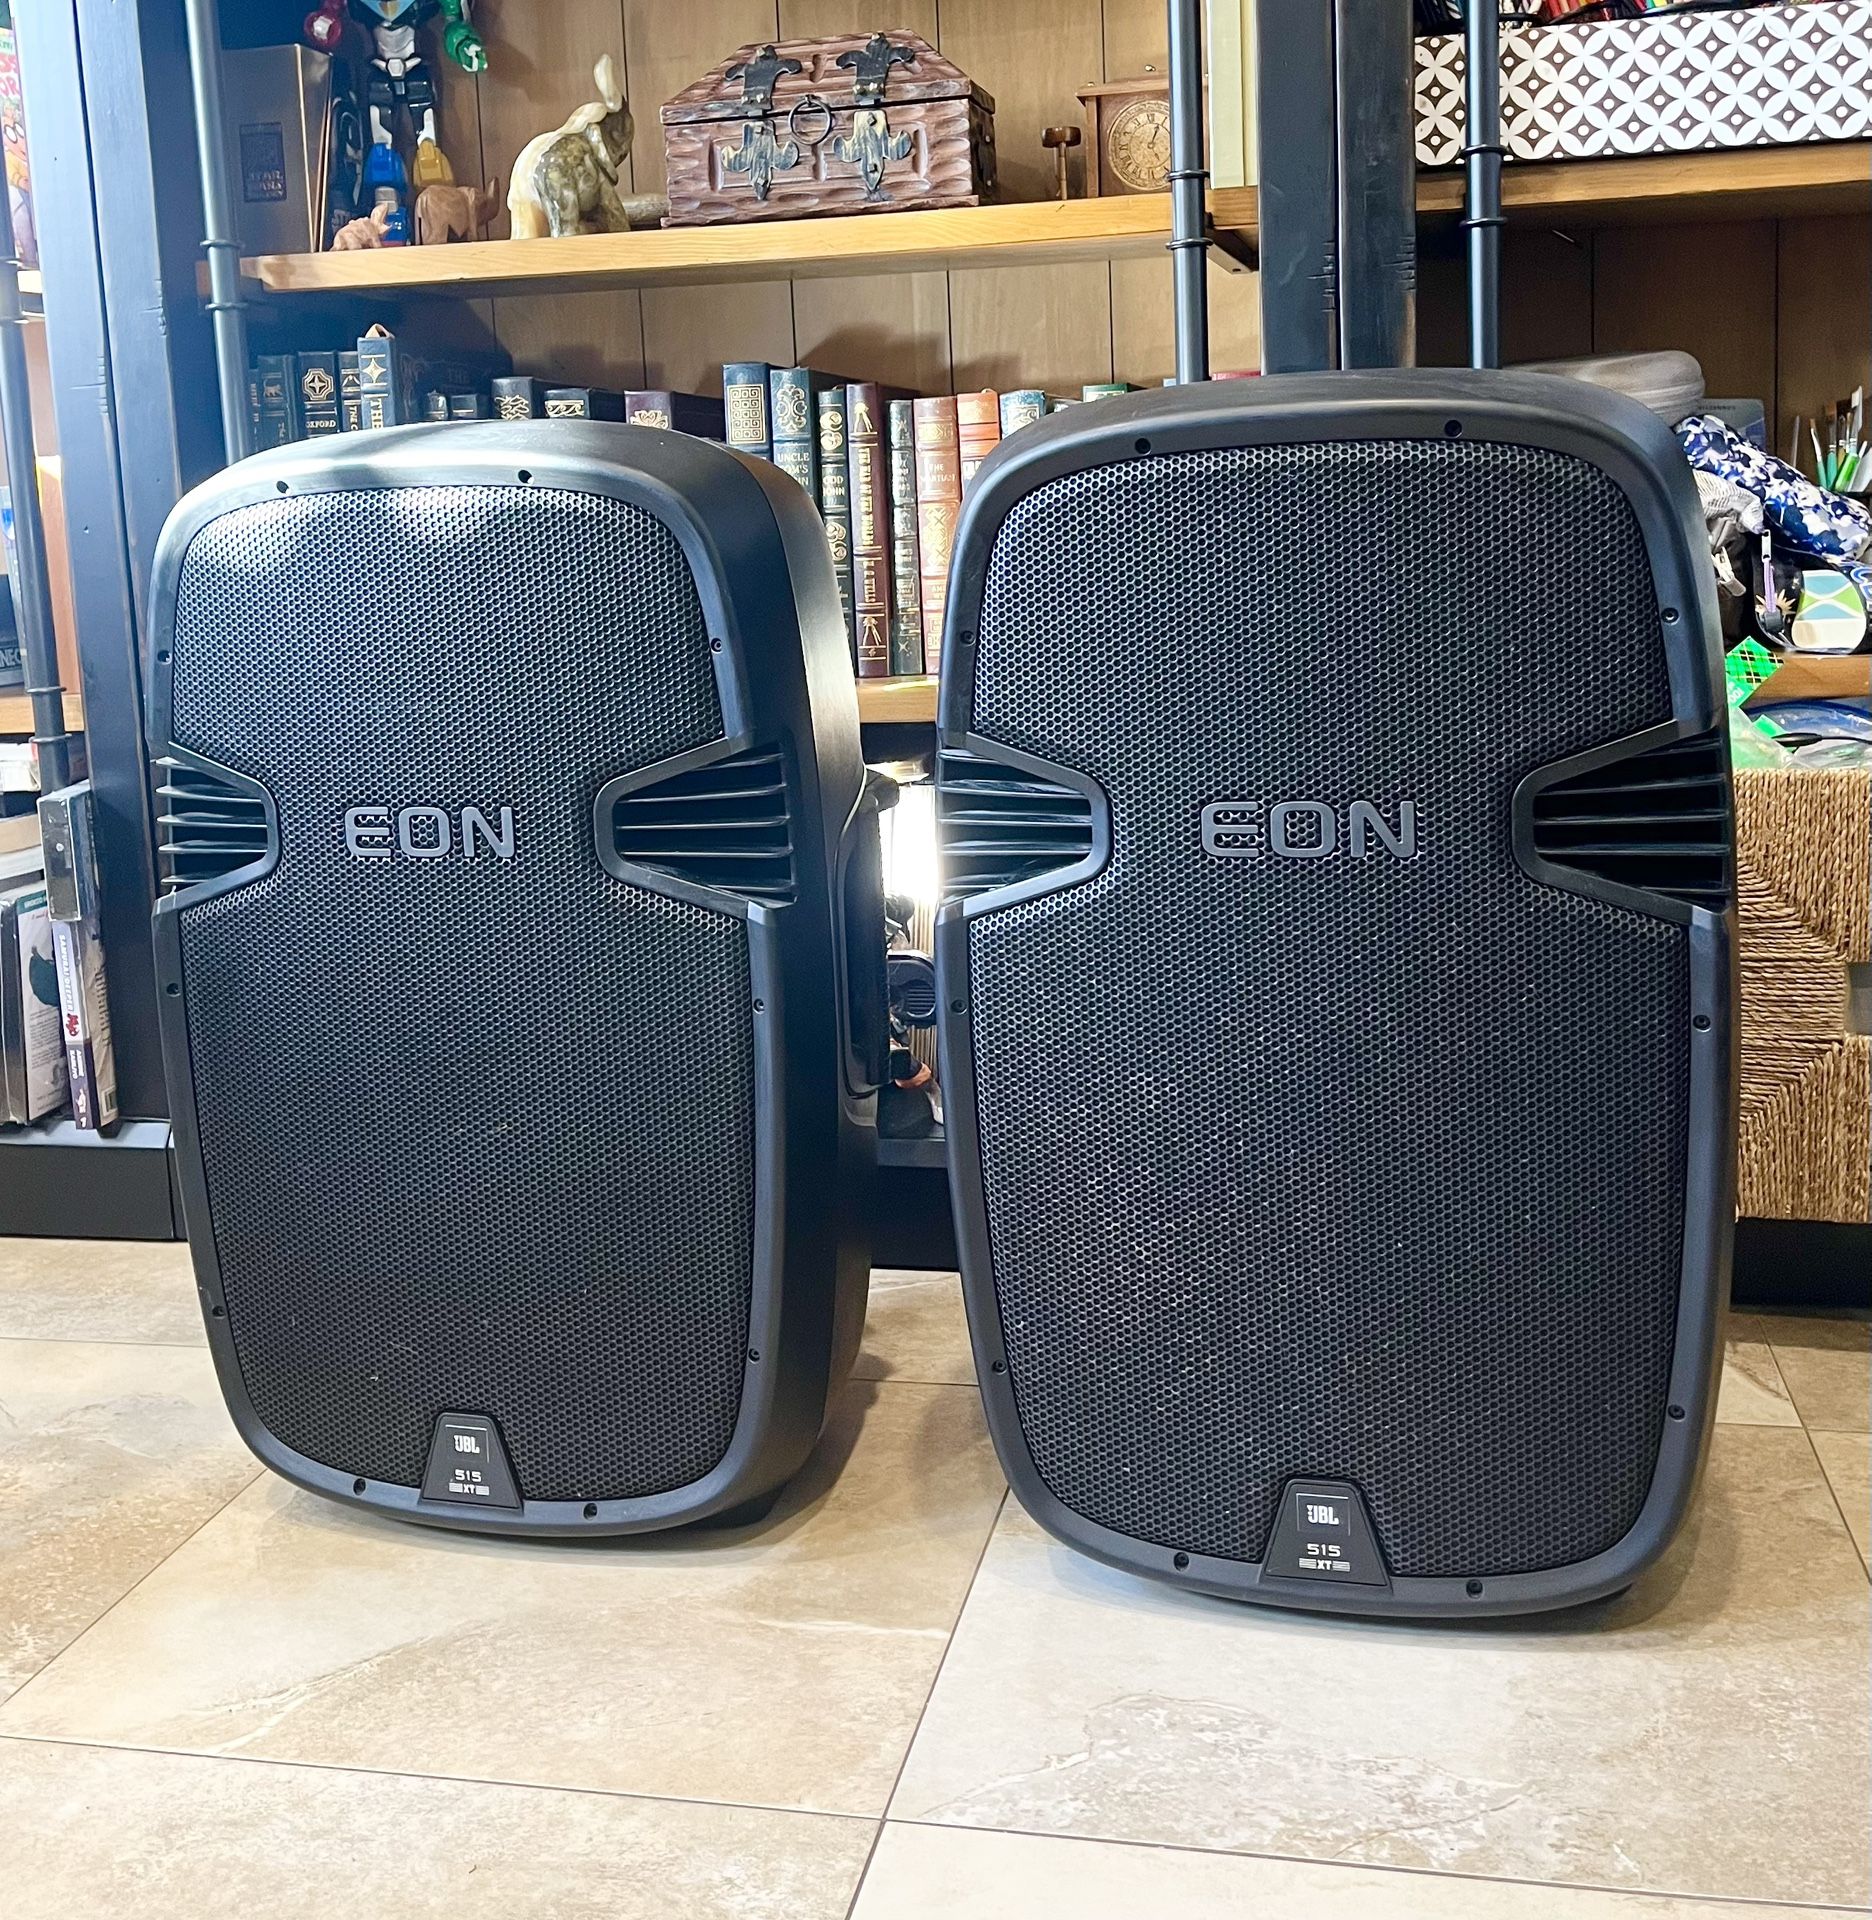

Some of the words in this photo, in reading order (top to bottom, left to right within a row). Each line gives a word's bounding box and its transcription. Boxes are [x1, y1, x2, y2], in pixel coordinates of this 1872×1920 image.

[370, 398, 384, 429] THE
[306, 420, 337, 428] OXFORD
[778, 453, 810, 462] UNCLE
[783, 464, 809, 474] OM'S
[344, 806, 515, 857] EON
[1201, 800, 1416, 858] EON
[59, 934, 70, 975] SAMURAI
[64, 977, 74, 1011] DEEPER
[453, 1435, 480, 1454] JBL
[455, 1469, 482, 1482] 515
[463, 1484, 476, 1494] XT
[1306, 1504, 1340, 1525] JBL
[1307, 1543, 1341, 1557] 515
[1317, 1560, 1332, 1570] XT
